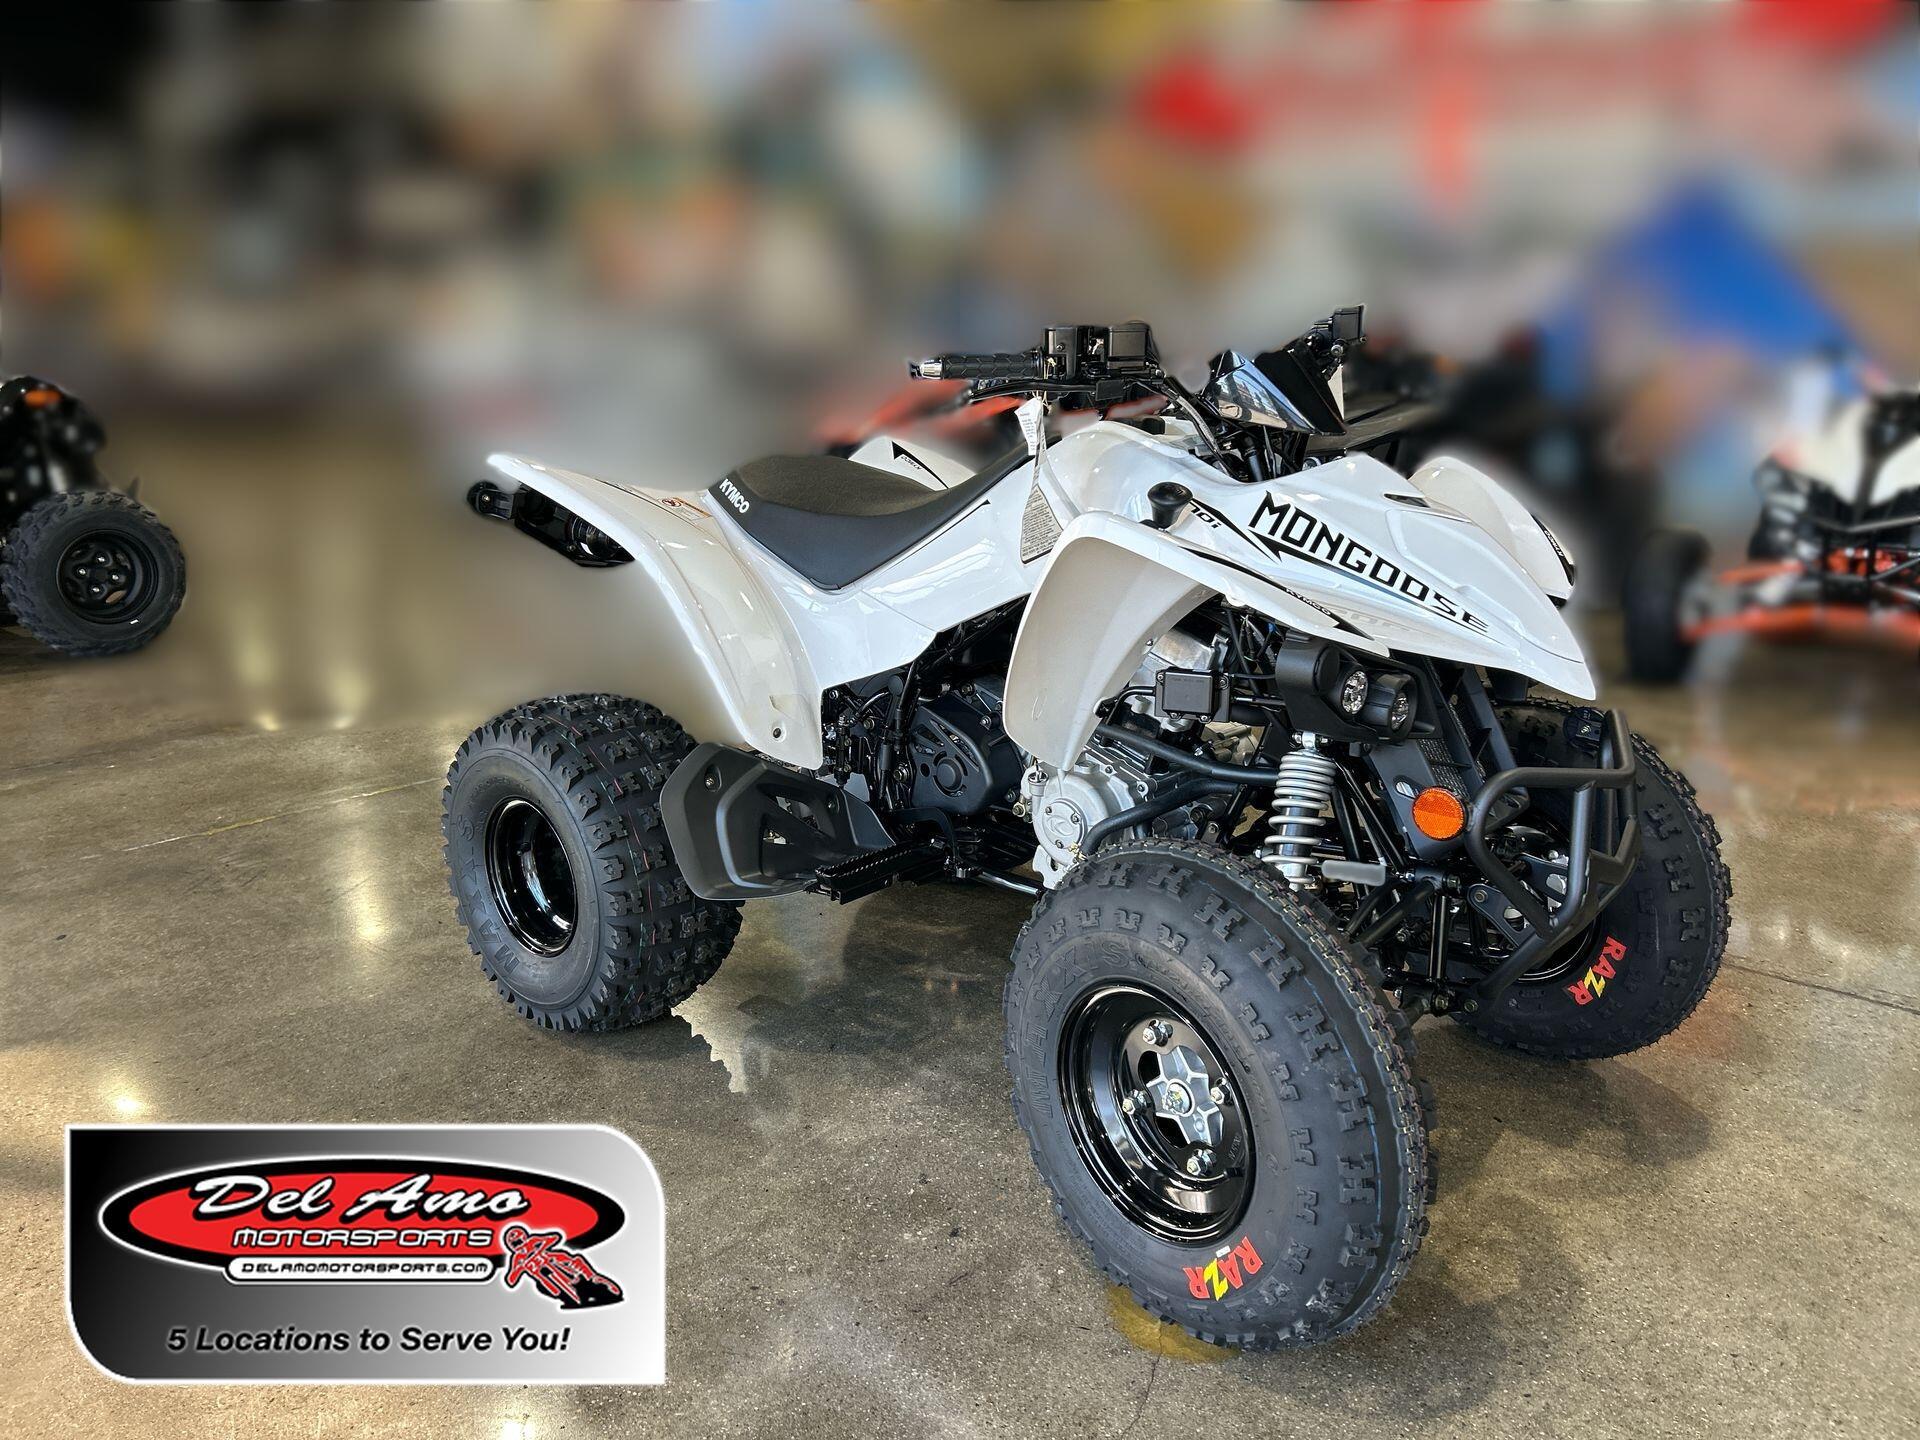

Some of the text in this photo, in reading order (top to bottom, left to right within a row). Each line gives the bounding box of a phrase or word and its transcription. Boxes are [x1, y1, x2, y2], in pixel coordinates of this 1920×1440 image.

[719, 478, 750, 514] KYMCO
[1248, 490, 1489, 633] MONGOOSE
[1285, 588, 1331, 616] KYMCO
[1567, 936, 1627, 1006] RAZR
[1182, 1236, 1264, 1301] RAZR
